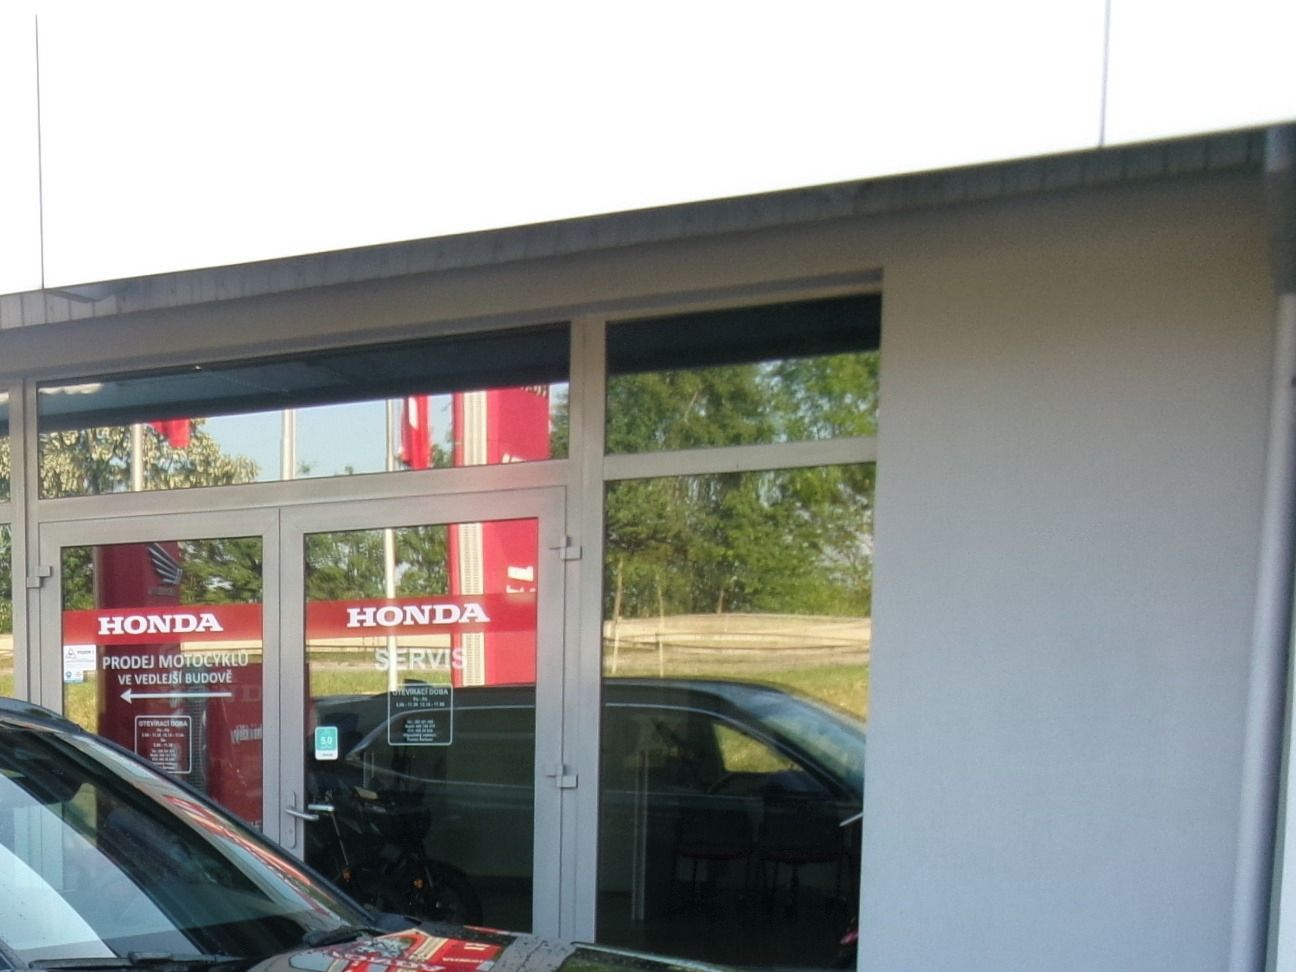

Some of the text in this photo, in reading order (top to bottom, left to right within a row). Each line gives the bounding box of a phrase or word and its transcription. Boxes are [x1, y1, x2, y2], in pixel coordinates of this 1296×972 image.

[97, 612, 224, 636] HONDA
[347, 603, 491, 628] HONDA
[103, 650, 249, 670] PRODEJ MOTOCYKLŮ
[375, 647, 466, 671] SERVIS
[118, 670, 232, 686] VE VEDLEJŠÍ BUDOVĚ
